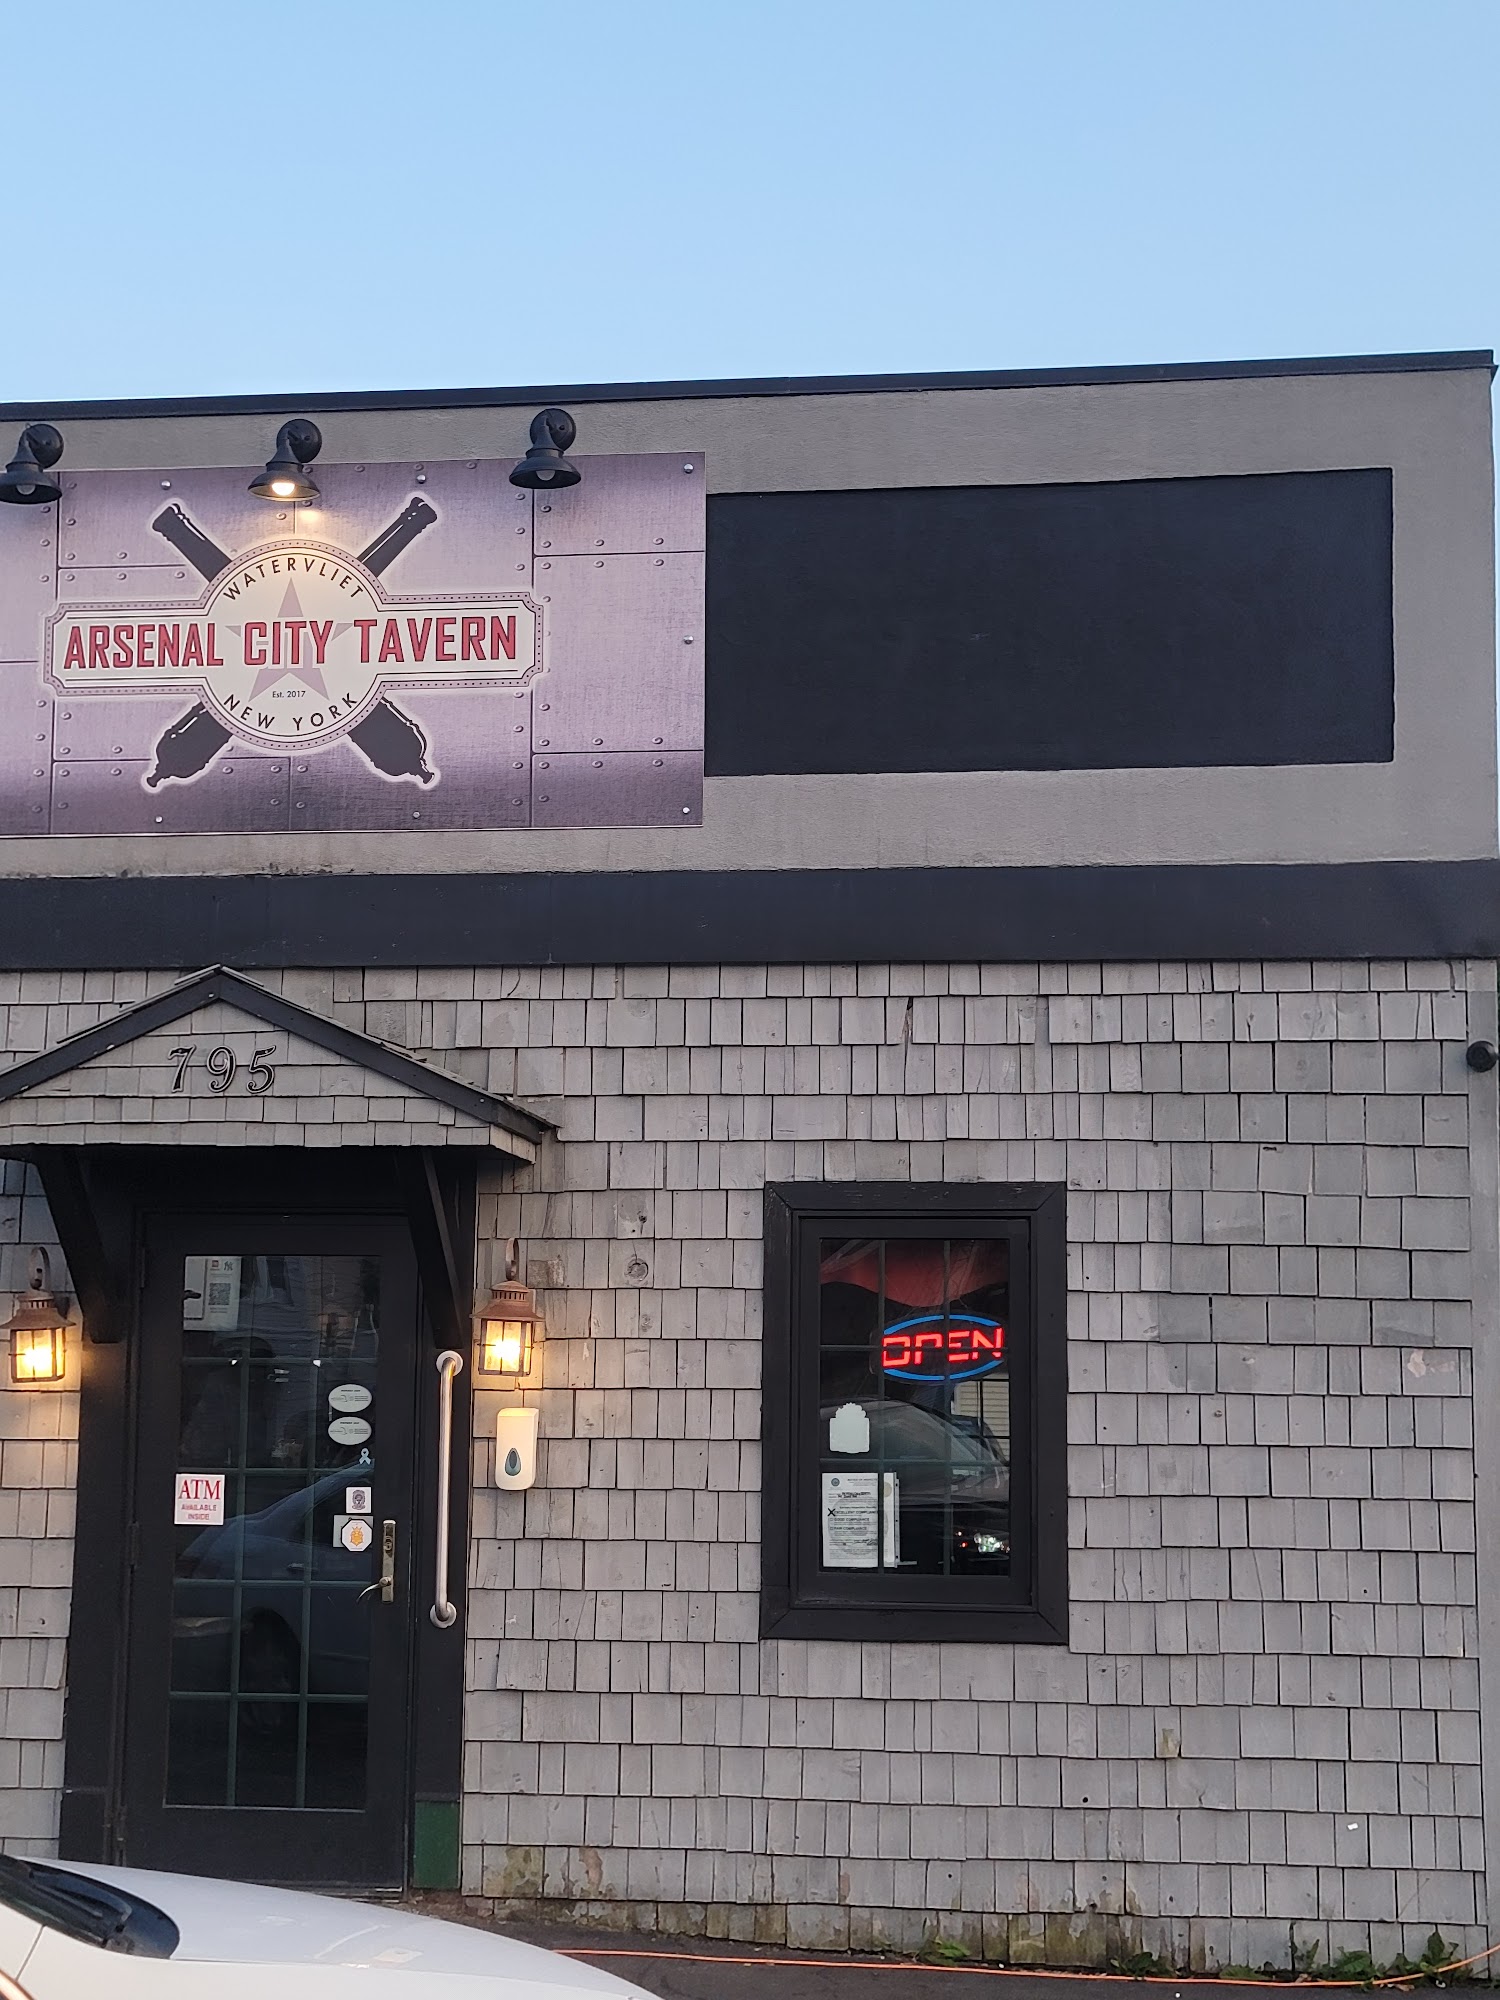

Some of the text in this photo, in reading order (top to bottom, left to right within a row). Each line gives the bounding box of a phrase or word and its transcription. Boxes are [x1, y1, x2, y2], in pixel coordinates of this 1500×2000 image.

[223, 557, 364, 601] WATERVLIET
[63, 615, 517, 670] ARSENAL CITY TAVERN
[223, 692, 358, 731] NEW YORK
[272, 690, 306, 699] Est. 2017
[167, 1044, 277, 1094] 795
[882, 1326, 1004, 1368] OPEN
[178, 1478, 222, 1500] ATM
[181, 1504, 217, 1512] AVAILABLE
[187, 1513, 210, 1521] INSIDE
